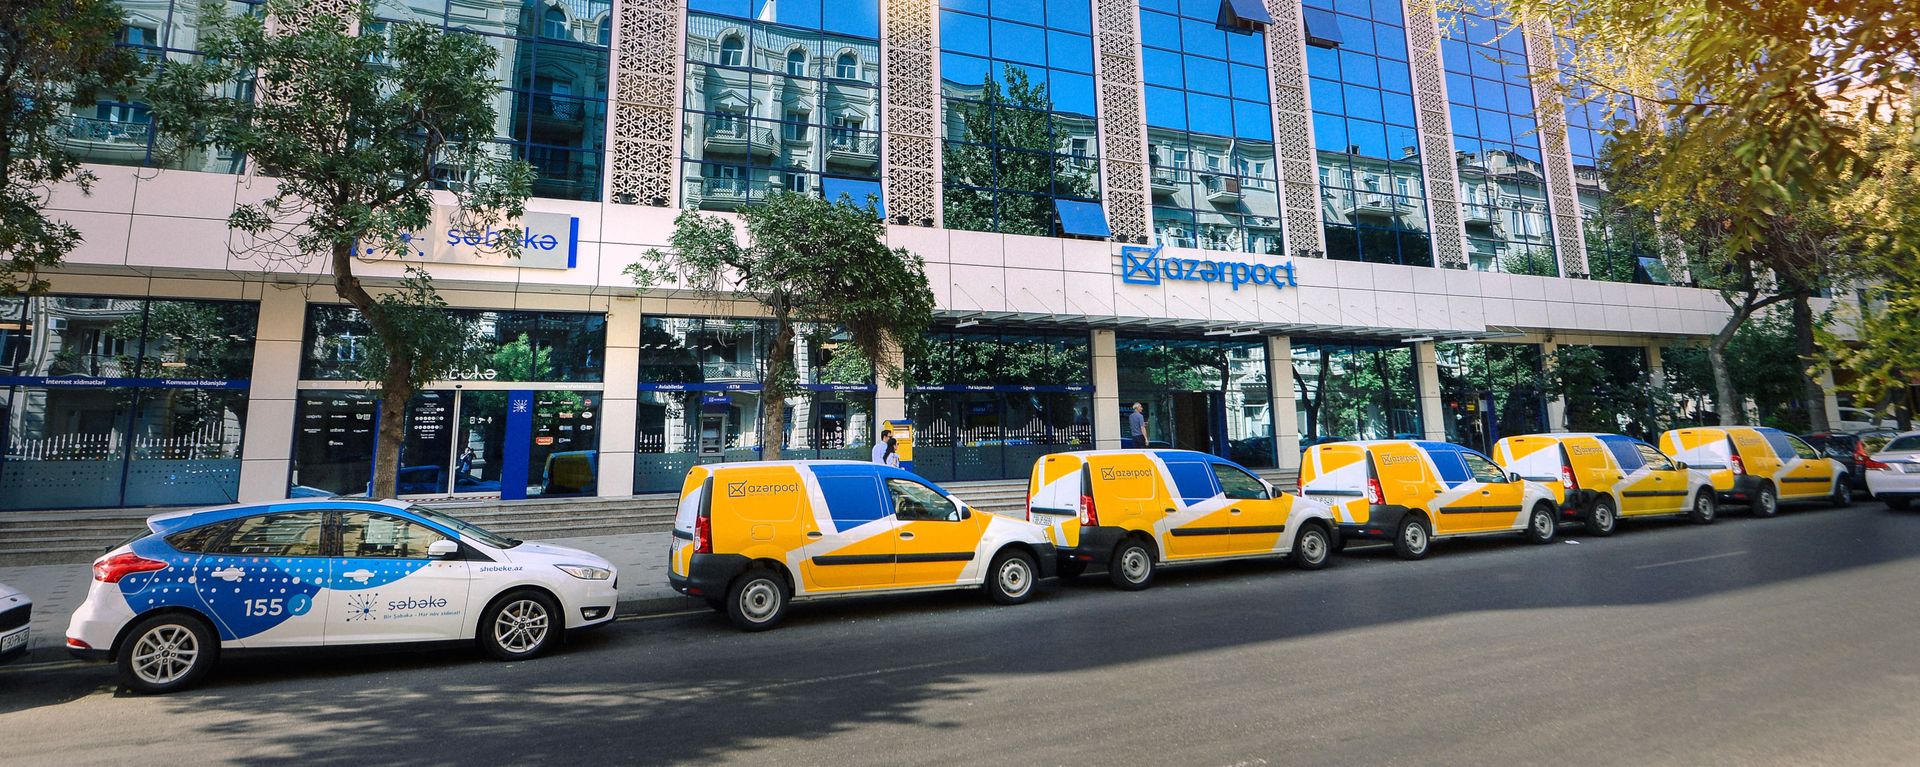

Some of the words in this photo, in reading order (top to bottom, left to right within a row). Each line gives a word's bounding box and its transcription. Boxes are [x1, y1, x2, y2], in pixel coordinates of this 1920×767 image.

[1164, 256, 1297, 291] azərpoçt
[748, 482, 799, 495] azərpoçt
[479, 565, 523, 573] shebeke.az
[243, 598, 284, 617] 155
